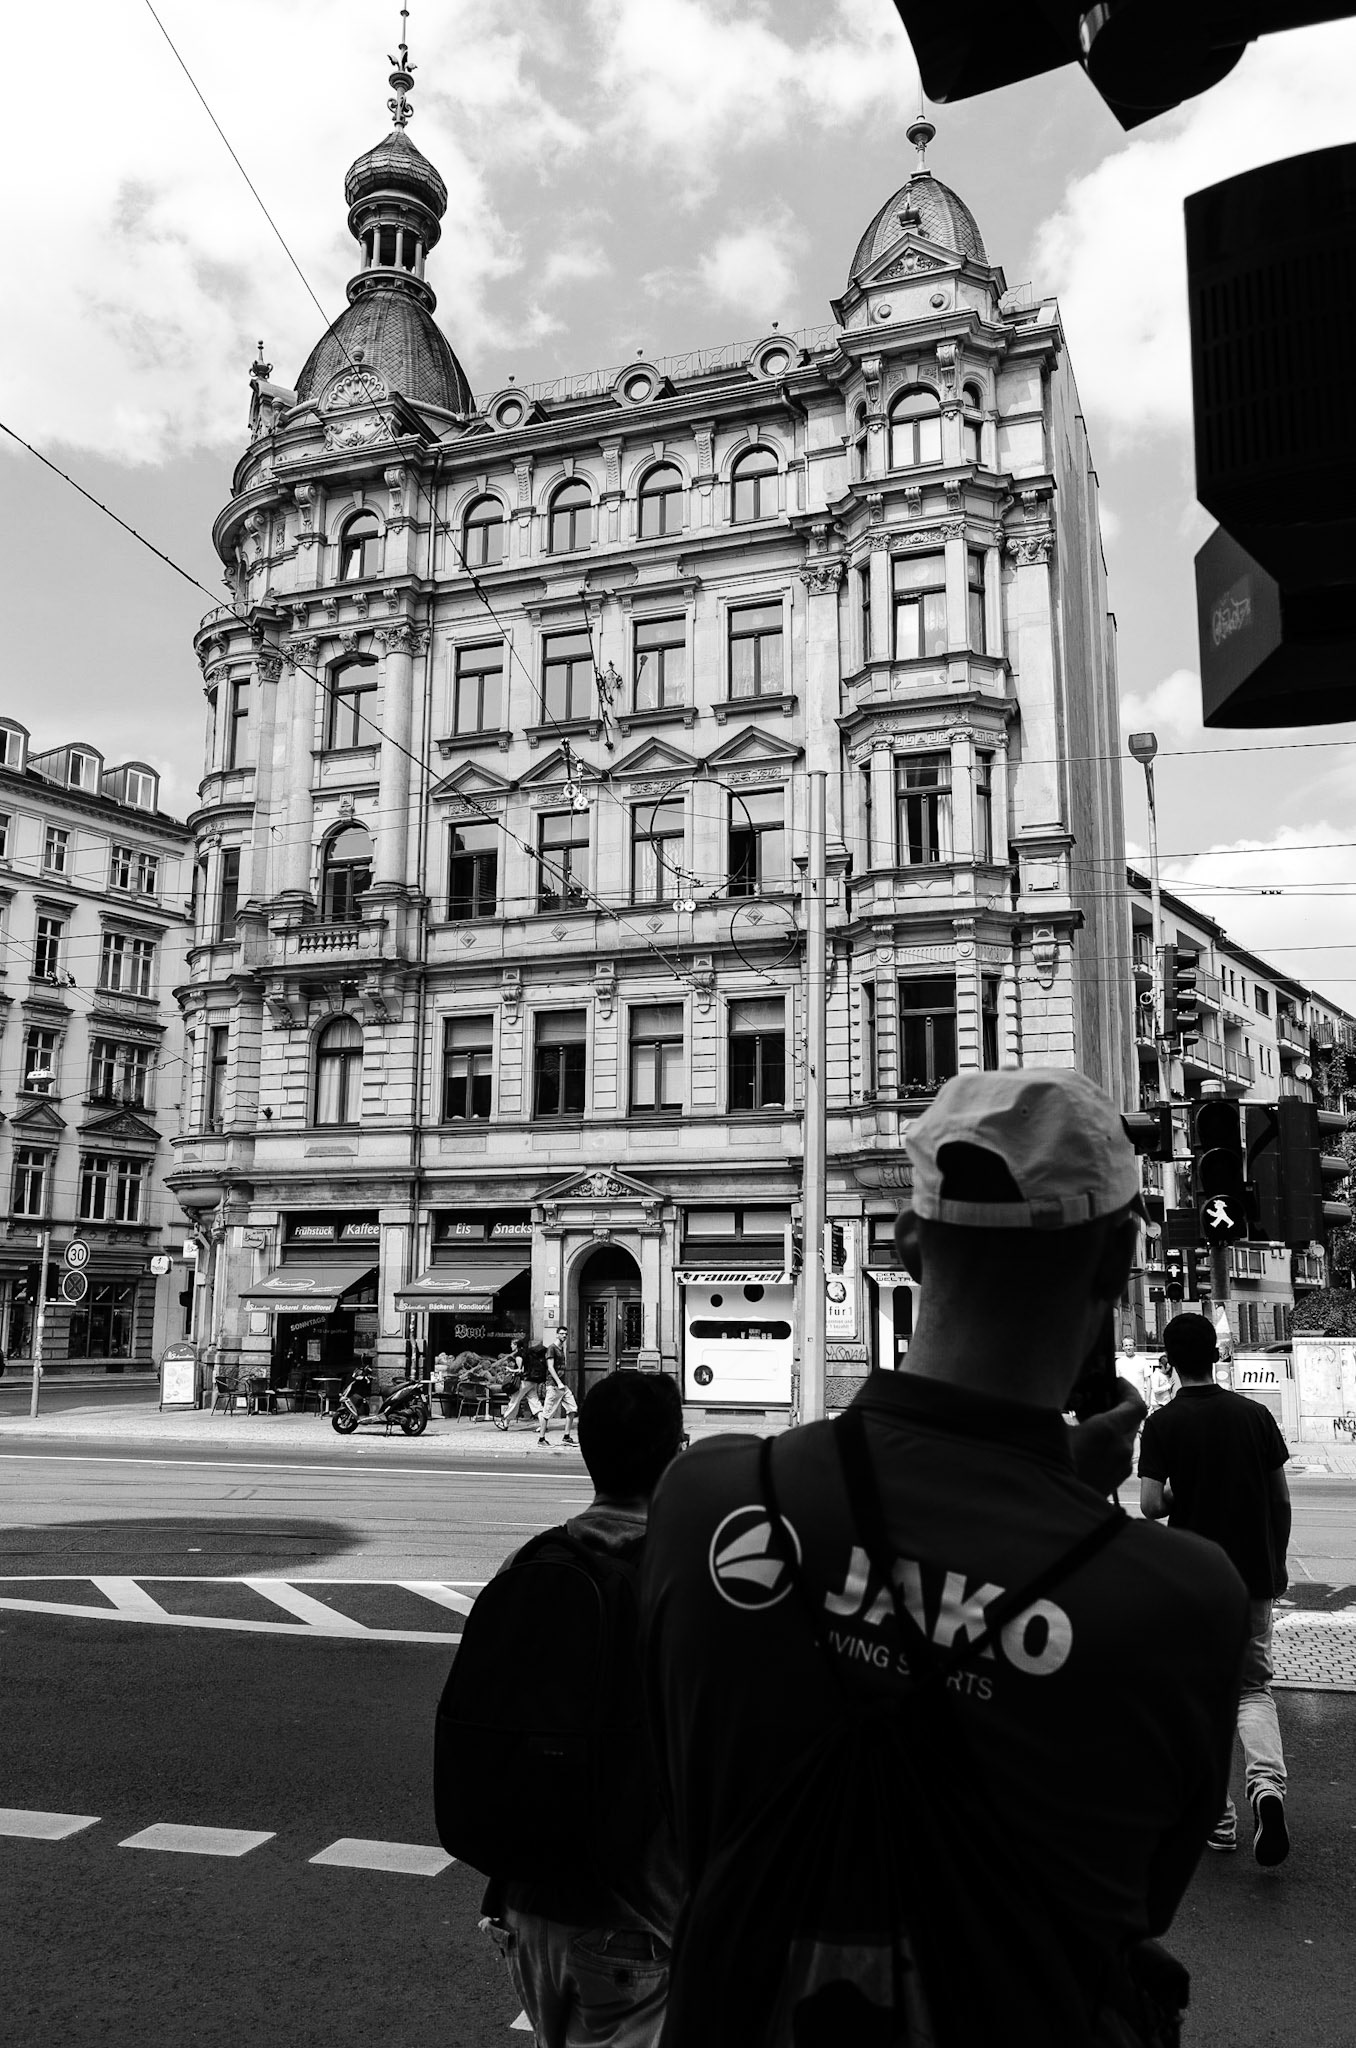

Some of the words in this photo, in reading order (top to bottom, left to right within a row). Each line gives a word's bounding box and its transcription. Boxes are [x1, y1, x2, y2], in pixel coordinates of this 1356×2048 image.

[295, 1225, 333, 1236] Frühstück
[347, 1223, 380, 1235] Kaffee
[455, 1223, 472, 1235] Eis
[494, 1222, 533, 1234] Snacks
[70, 1248, 85, 1261] 30
[828, 1305, 846, 1316] für
[290, 1316, 326, 1331] SONNTAGS
[1242, 1368, 1279, 1383] min.
[823, 1545, 1074, 1677] JAKO
[813, 1629, 890, 1669] IVING
[895, 1651, 993, 1701] SRTS
